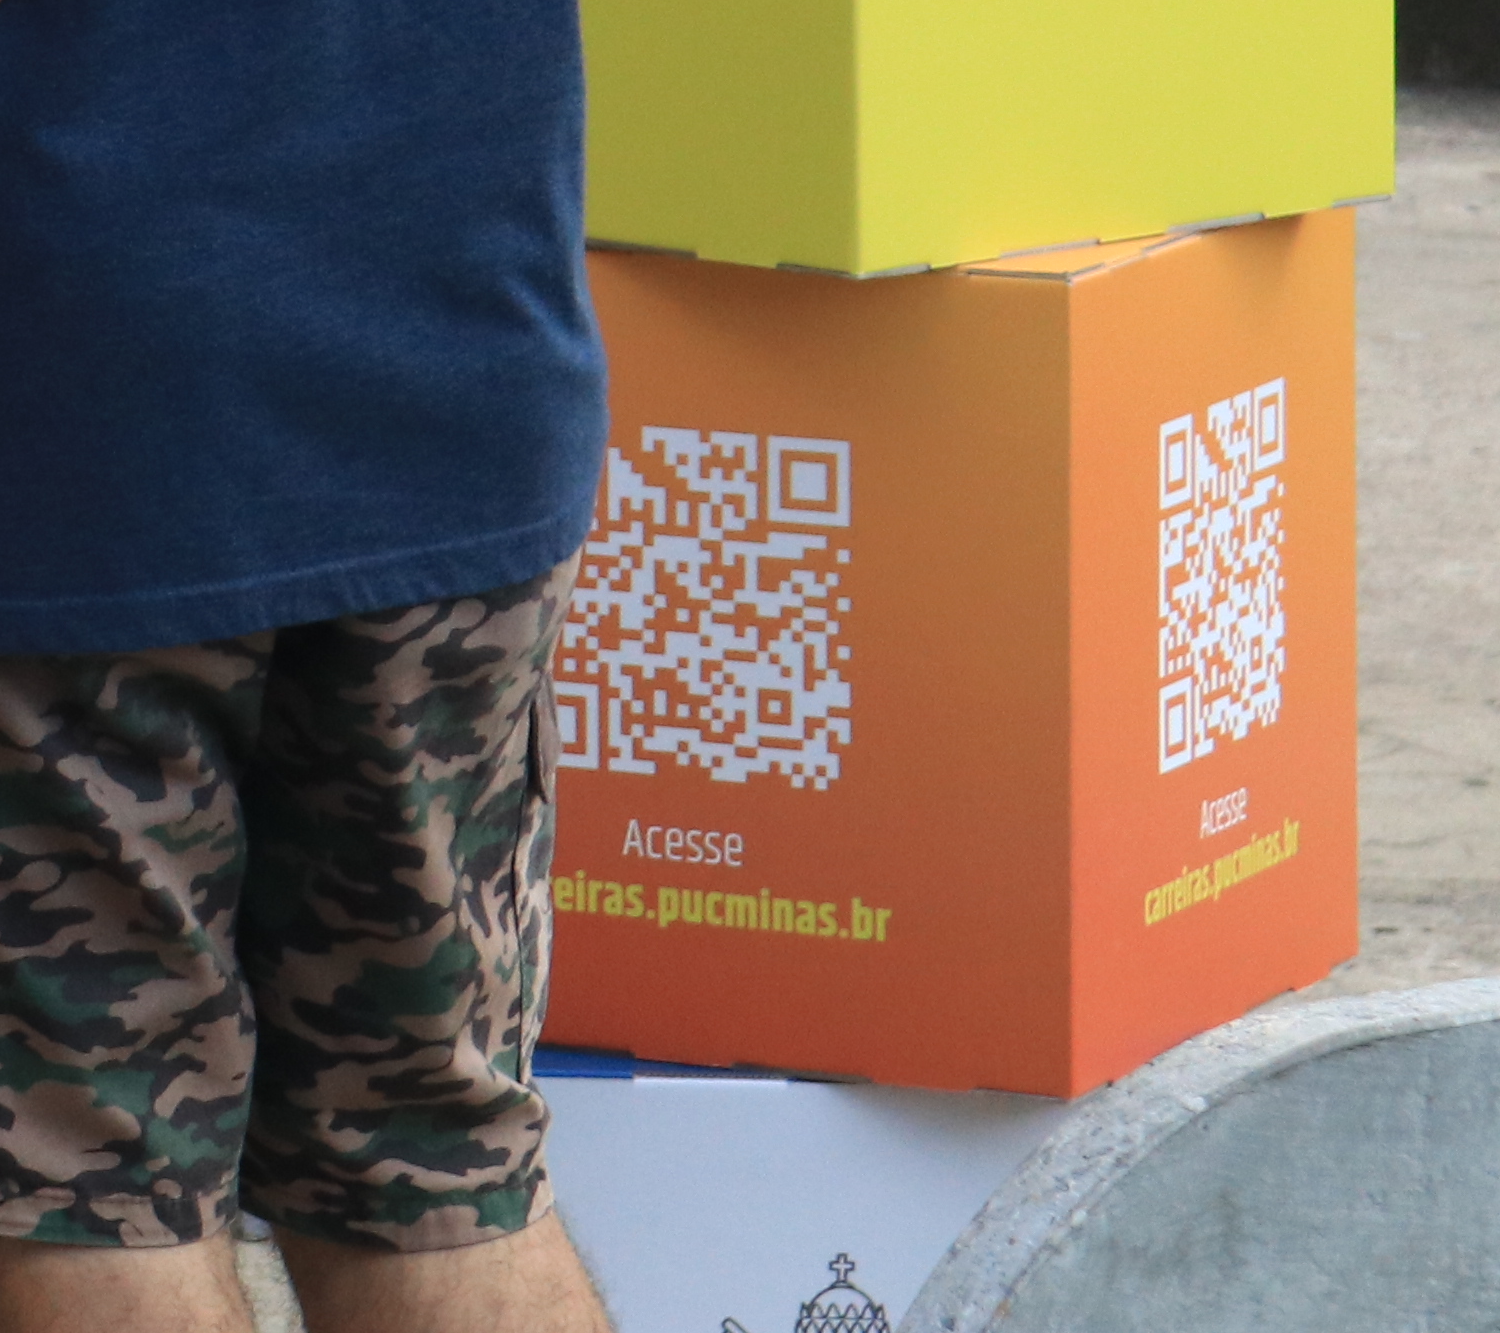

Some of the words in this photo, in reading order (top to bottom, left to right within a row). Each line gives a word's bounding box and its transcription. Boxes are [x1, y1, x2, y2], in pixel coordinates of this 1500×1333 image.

[1199, 786, 1248, 839] Acesse
[622, 818, 744, 868] Acesse
[550, 869, 893, 942] eiras.pucminas.br
